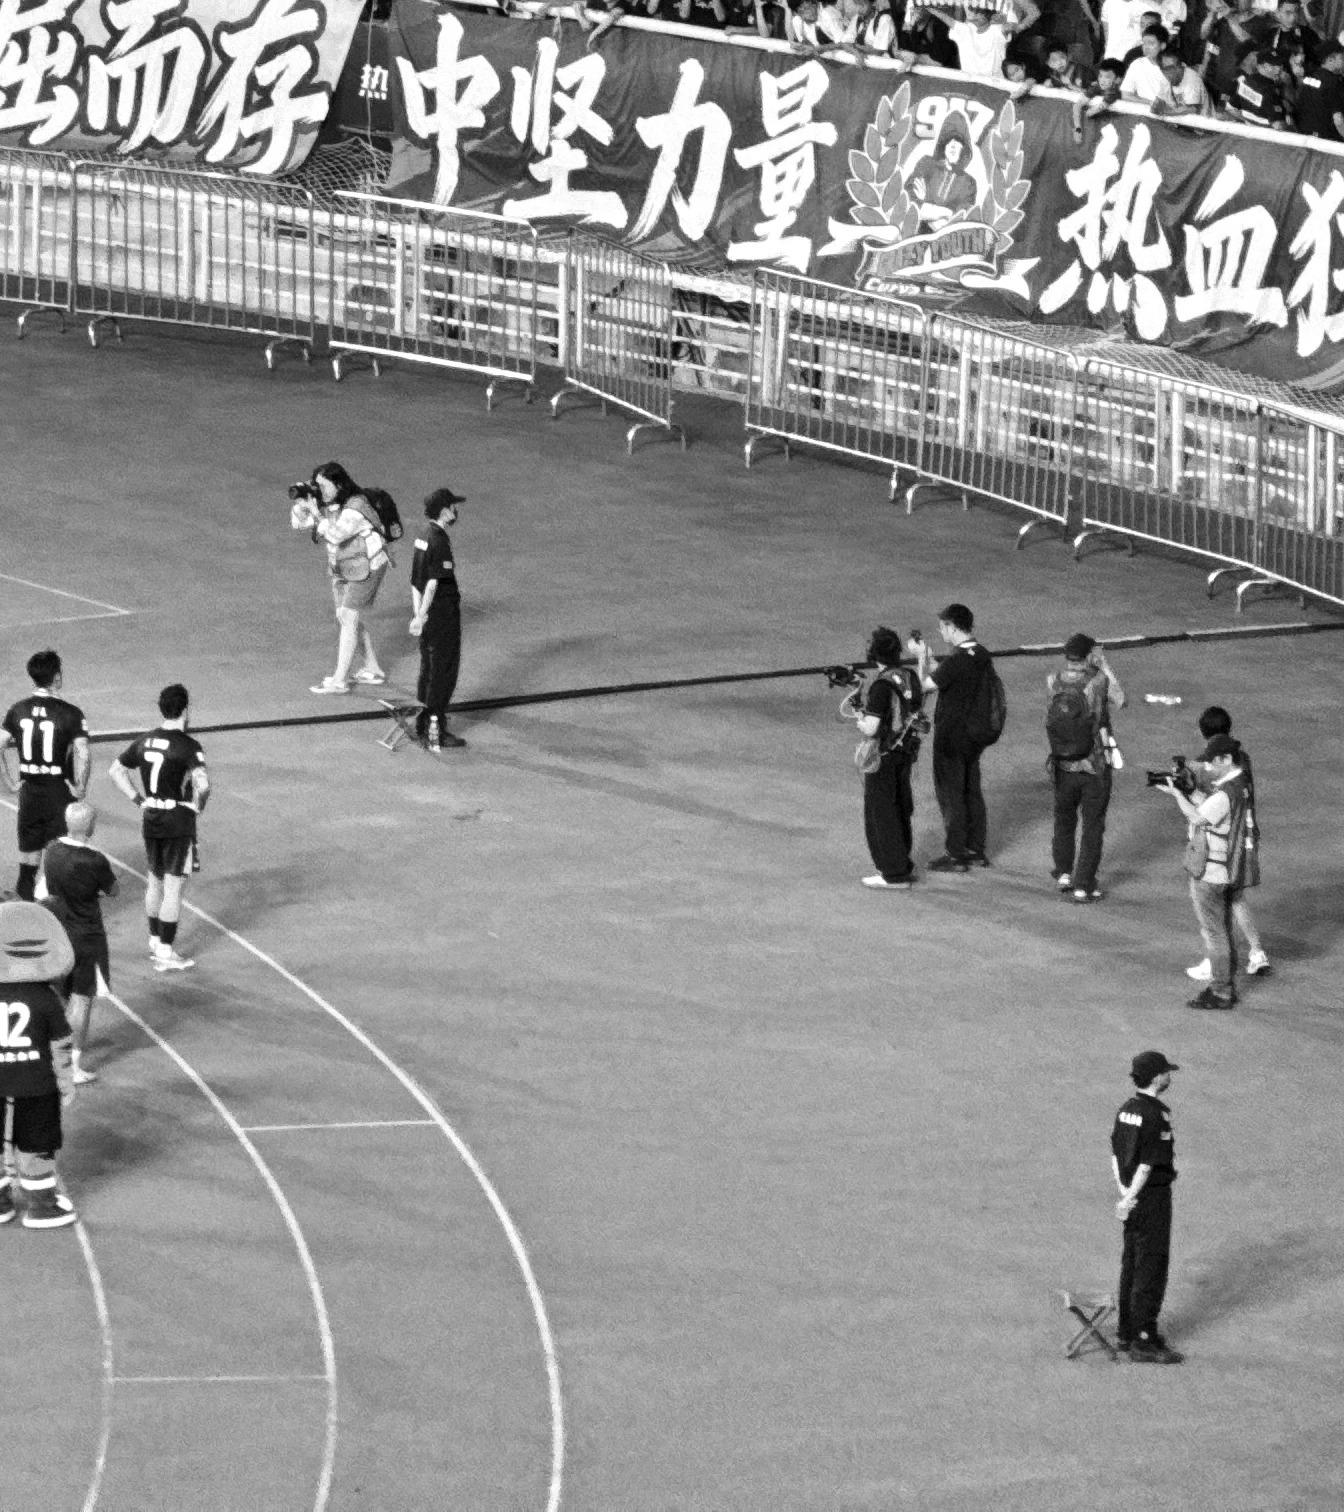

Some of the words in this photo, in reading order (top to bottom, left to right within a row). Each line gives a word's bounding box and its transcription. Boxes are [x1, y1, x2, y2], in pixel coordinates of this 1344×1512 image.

[395, 12, 838, 274] 中坚力量
[19, 717, 55, 763] 11
[143, 751, 164, 795] 7
